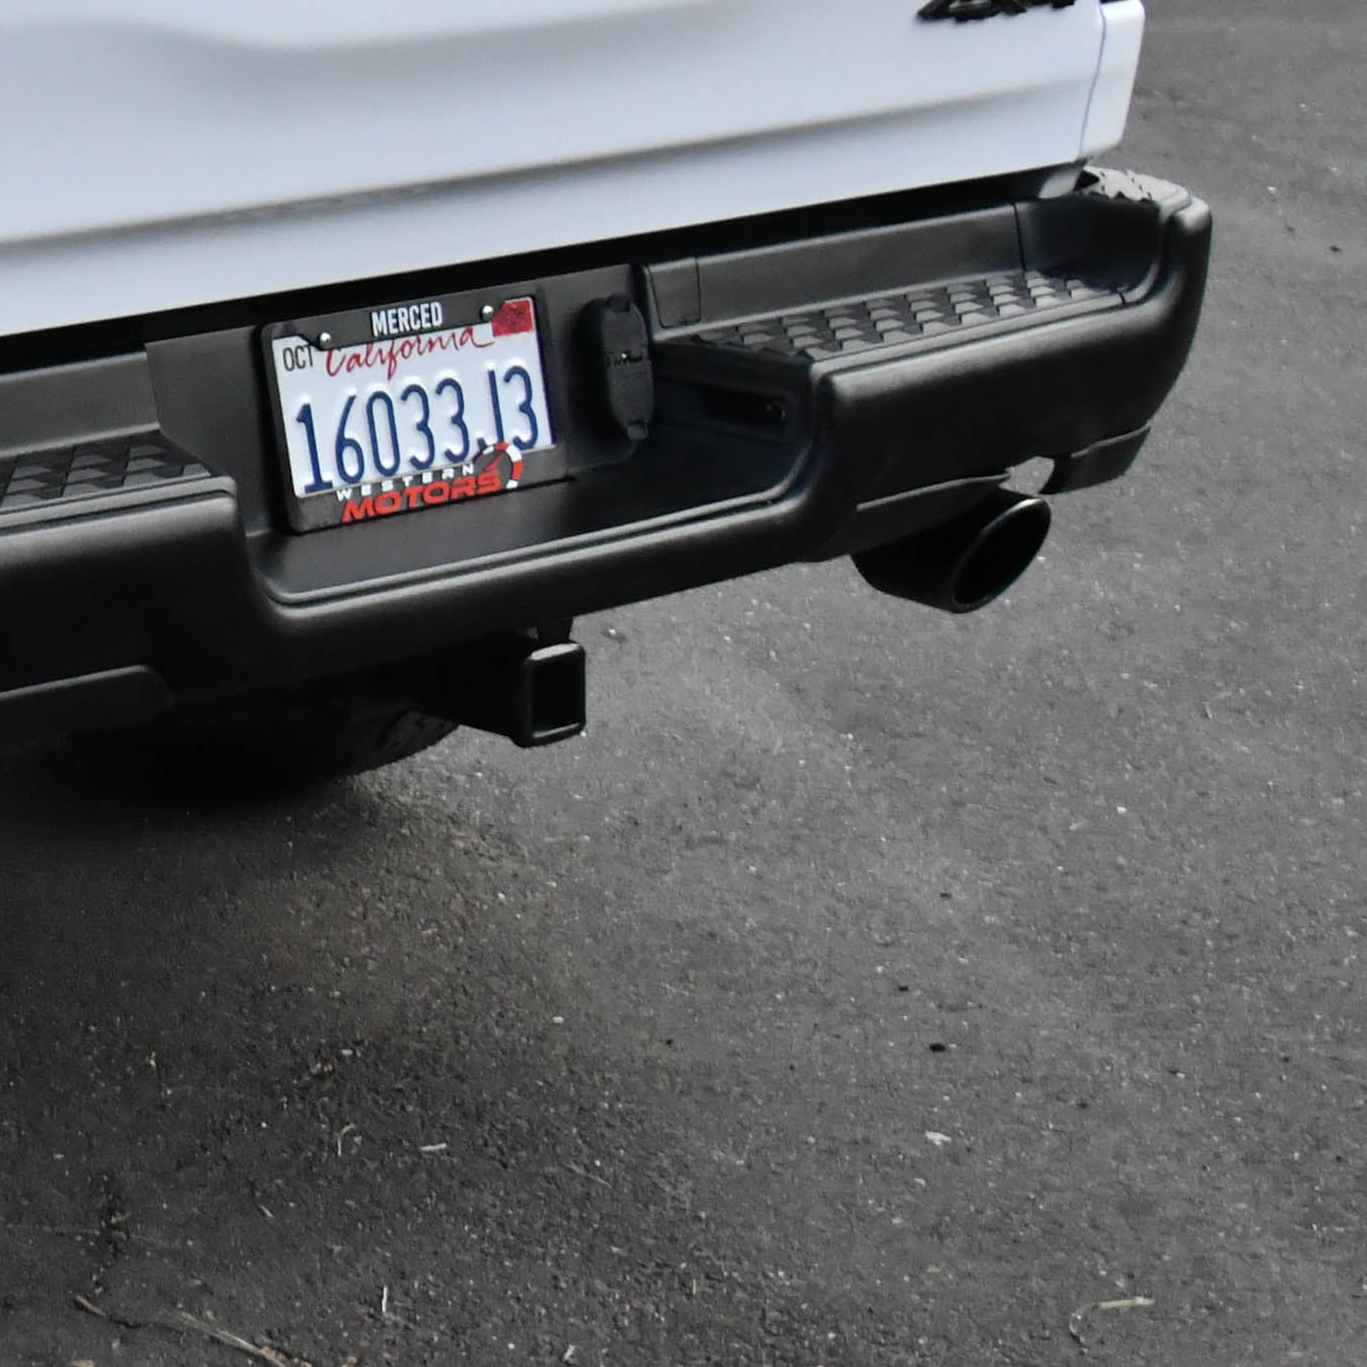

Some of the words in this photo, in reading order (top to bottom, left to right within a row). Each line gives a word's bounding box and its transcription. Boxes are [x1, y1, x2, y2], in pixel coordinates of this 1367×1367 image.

[371, 301, 443, 337] MERCED
[283, 344, 315, 372] OCT
[325, 326, 495, 381] California
[296, 365, 539, 494] 16033J3
[336, 463, 475, 502] WESTERN
[341, 469, 502, 524] MOTORS
